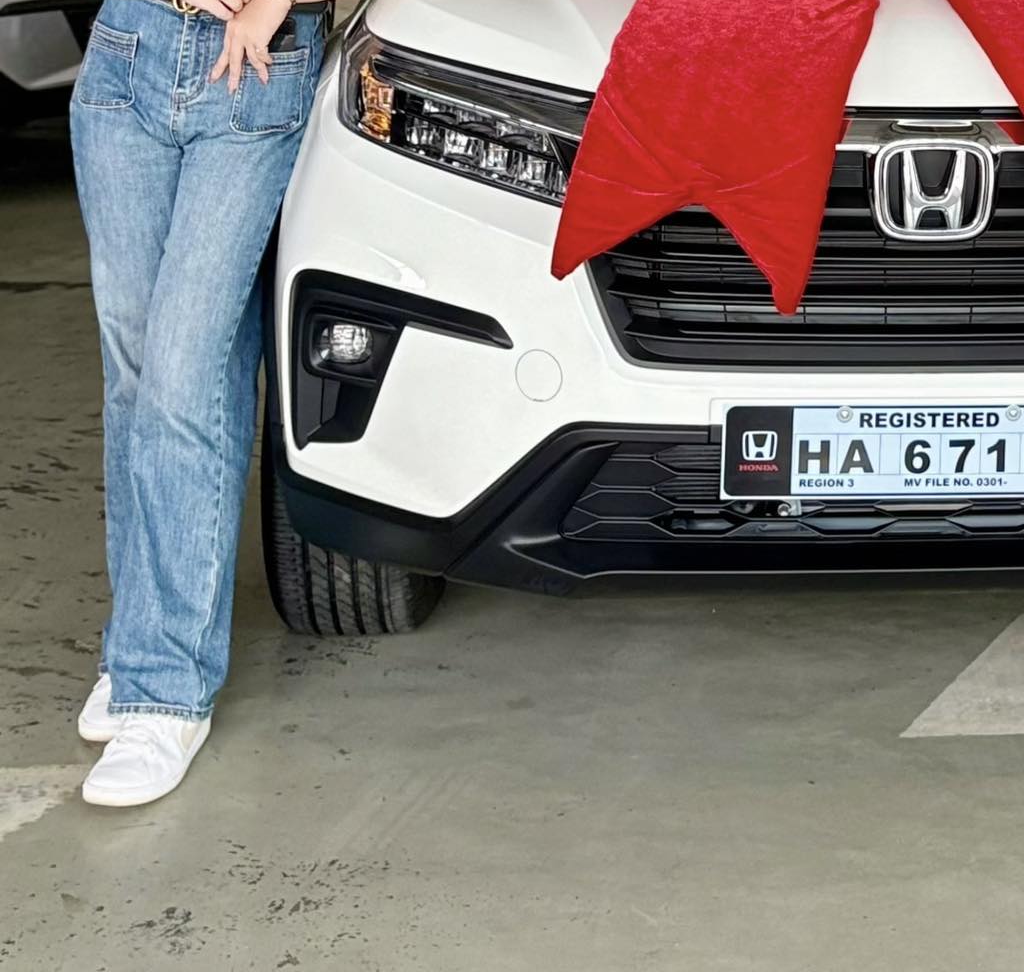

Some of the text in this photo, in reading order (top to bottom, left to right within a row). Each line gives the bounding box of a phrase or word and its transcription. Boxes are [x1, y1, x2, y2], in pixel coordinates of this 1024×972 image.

[859, 412, 999, 428] REGISTERED
[798, 439, 874, 474] HA
[738, 463, 779, 472] HONDA
[799, 478, 855, 488] REGION 3
[904, 477, 1008, 487] MV FILE NO. 0301-
